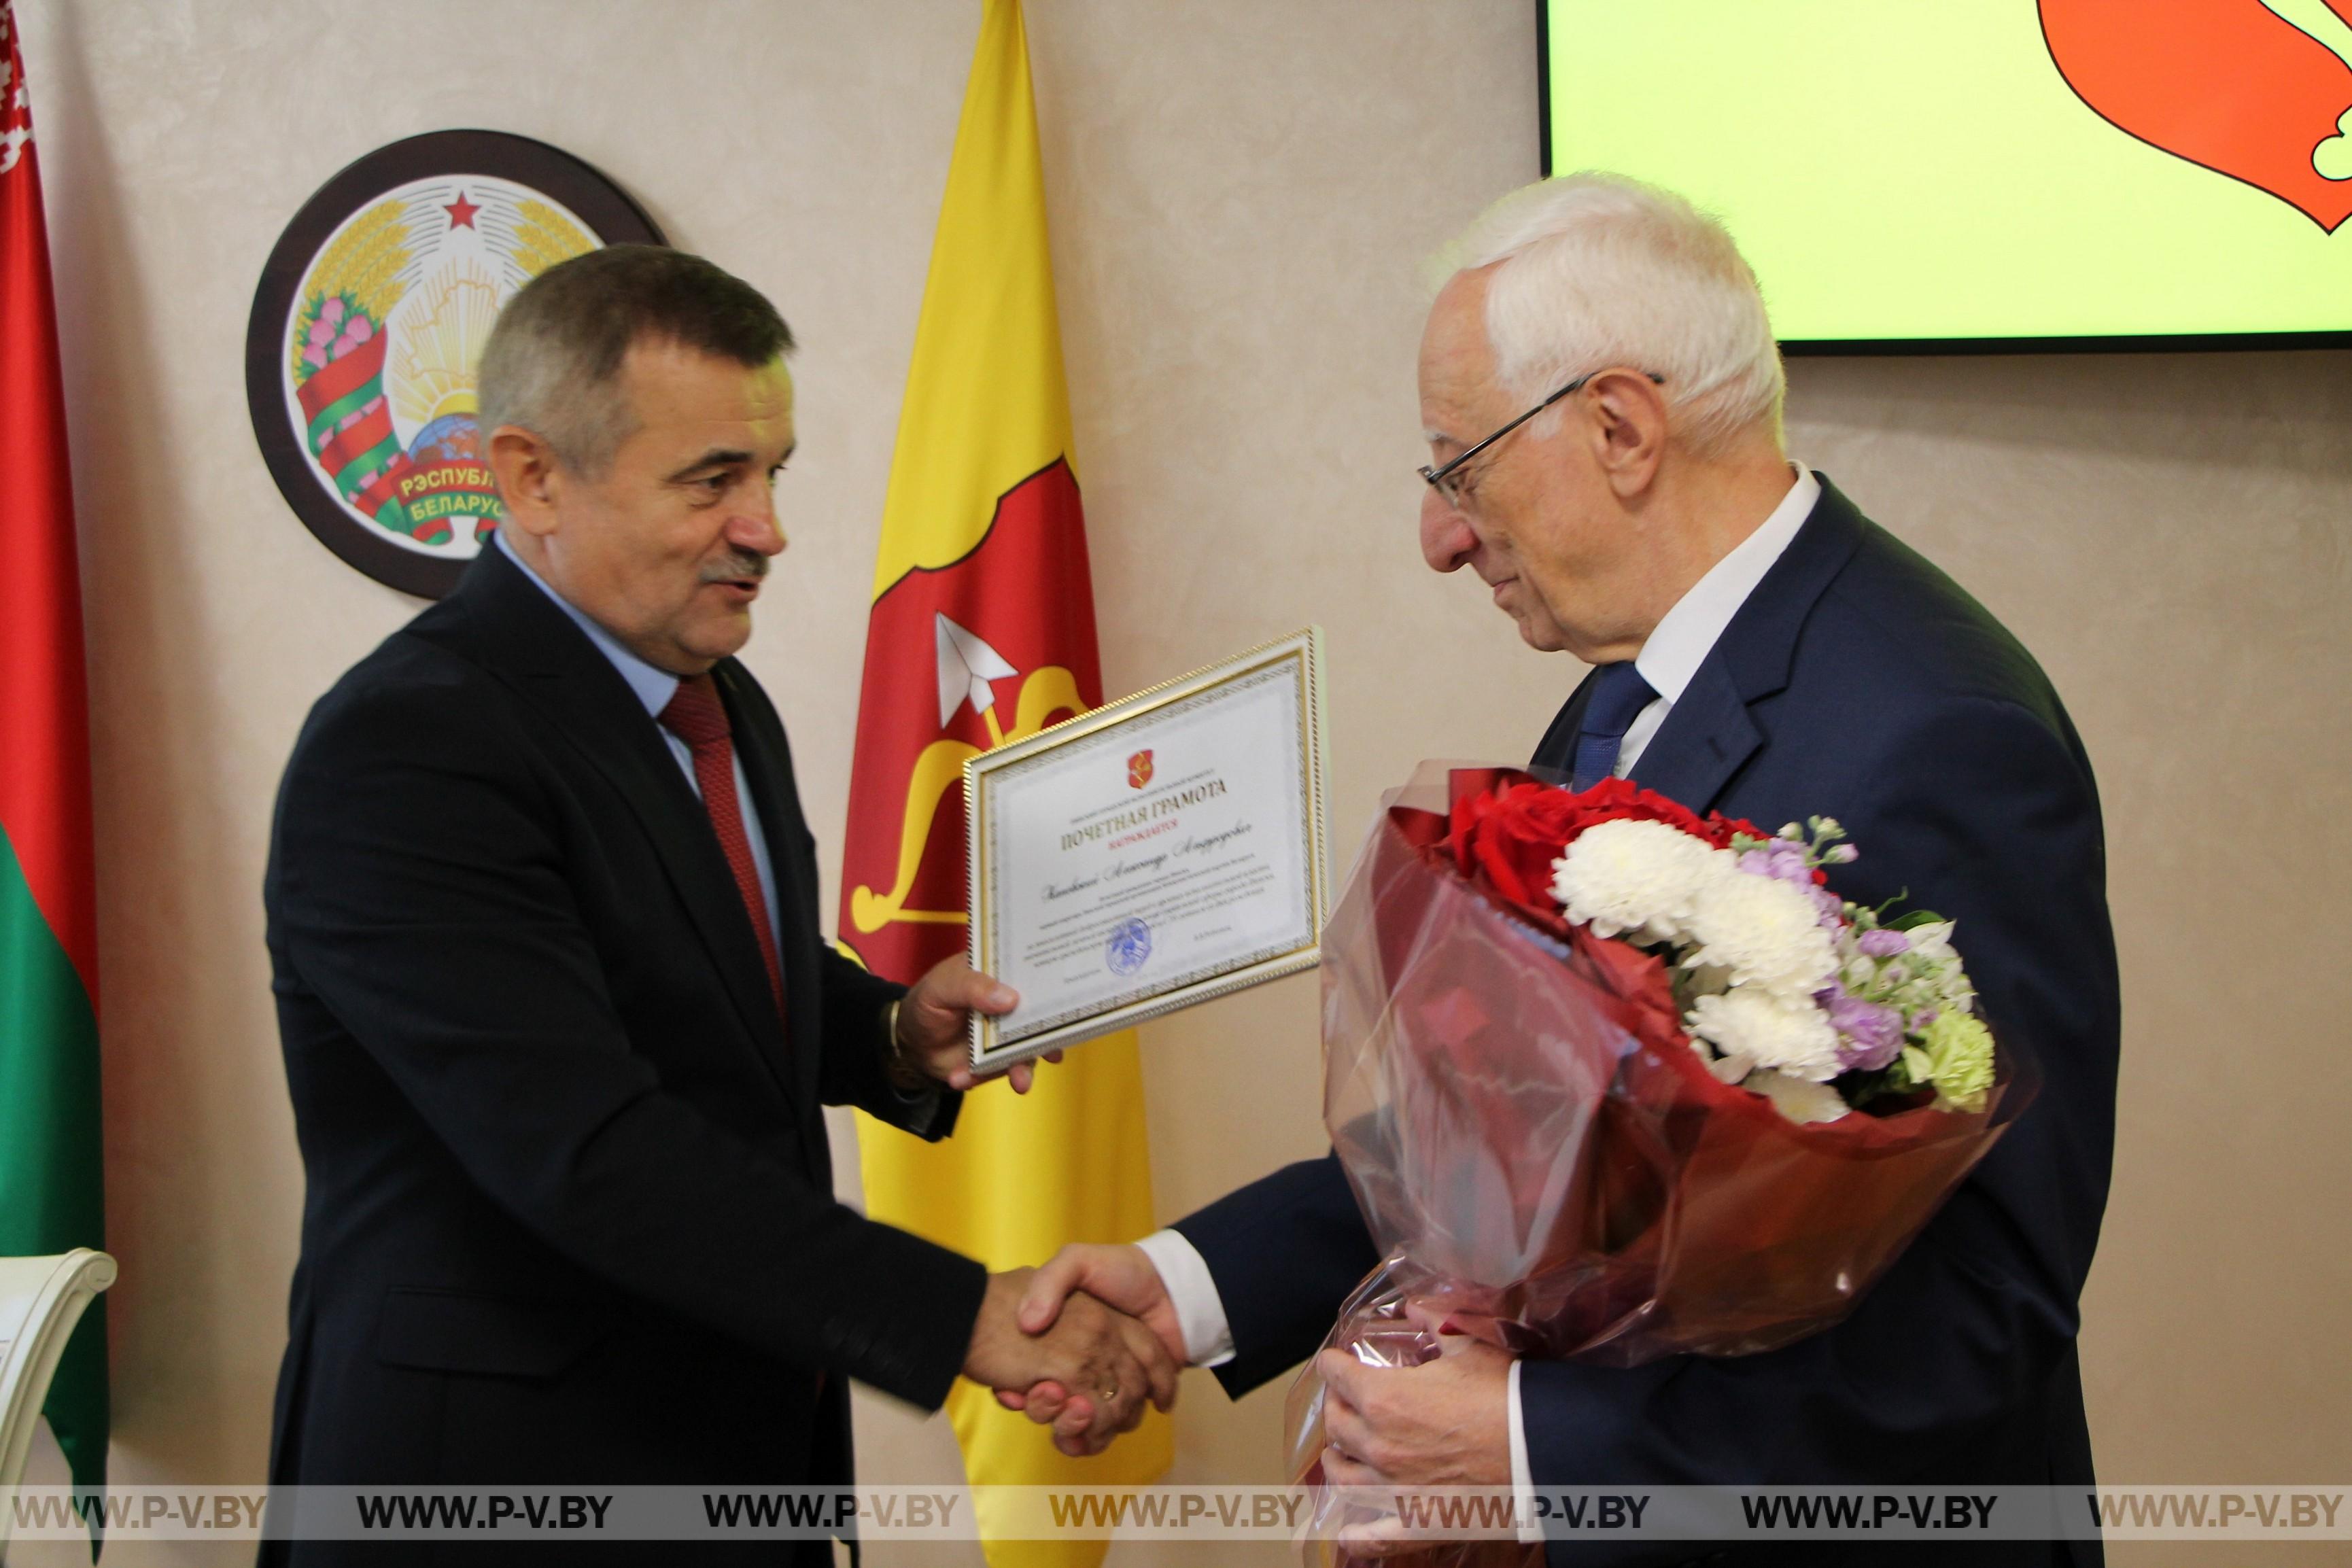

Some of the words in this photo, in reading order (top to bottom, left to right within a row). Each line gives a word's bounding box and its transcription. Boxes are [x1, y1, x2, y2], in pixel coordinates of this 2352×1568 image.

[400, 467, 494, 497] РЭСПУБЛ
[410, 495, 502, 521] БЕЛАРУС
[1060, 806, 1147, 851] ПОЧЕТНАЯ
[1152, 778, 1227, 818] ГРАМОТА
